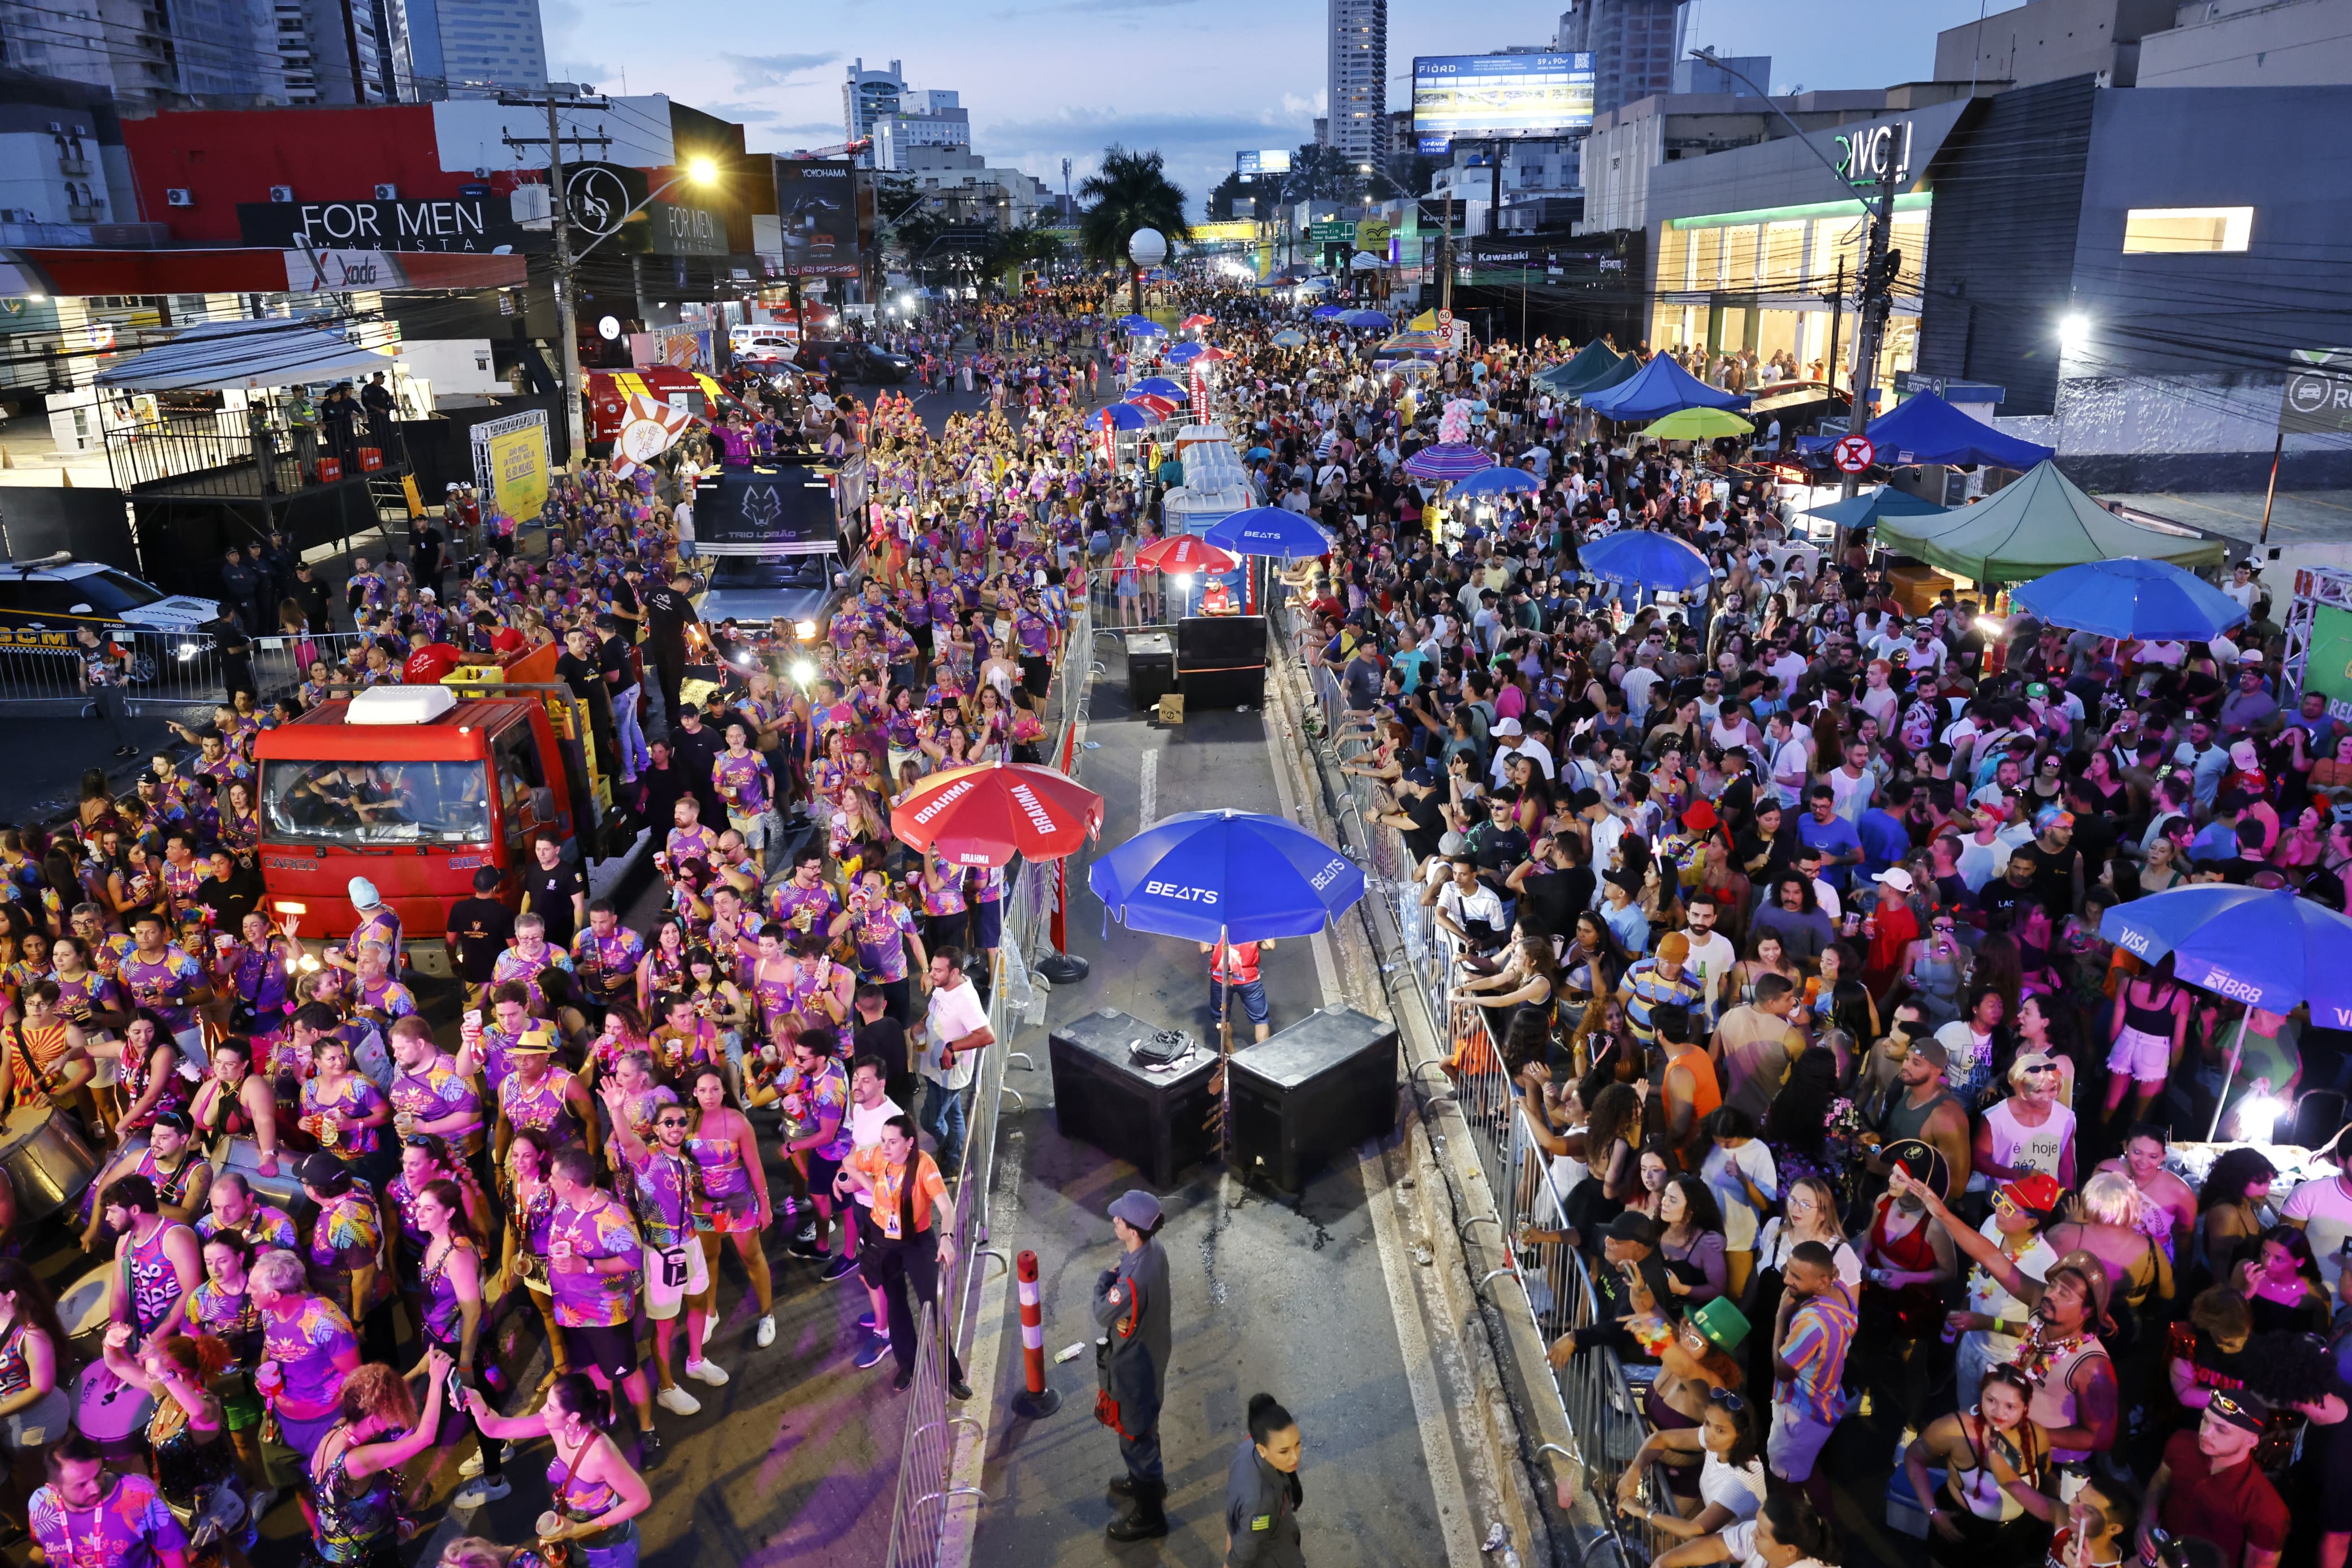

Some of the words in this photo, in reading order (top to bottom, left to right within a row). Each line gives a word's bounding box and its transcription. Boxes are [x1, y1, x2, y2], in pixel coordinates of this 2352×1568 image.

[801, 168, 847, 177] YOKOHAMA
[301, 203, 382, 238] FOR
[396, 201, 485, 236] MEN
[668, 207, 690, 237] FOR
[691, 209, 714, 239] MEN
[1478, 251, 1528, 262] Kawasaki
[756, 530, 797, 538] LOBÃO
[1244, 531, 1281, 539] BEATS
[1175, 541, 1191, 562] BRAHMA
[1605, 572, 1623, 584] VISA
[914, 780, 975, 825] BRAHMA
[1010, 783, 1057, 835] BRAHMA
[262, 856, 319, 870] CARGO
[960, 852, 990, 864] BRAHMA
[1310, 858, 1346, 891] BEATS
[1144, 880, 1219, 904] BEATS
[2121, 926, 2150, 956] VISA
[2221, 979, 2263, 1003] BRB
[2013, 1142, 2020, 1154] é
[2033, 1141, 2058, 1156] hoje
[2013, 1159, 2036, 1169] né?
